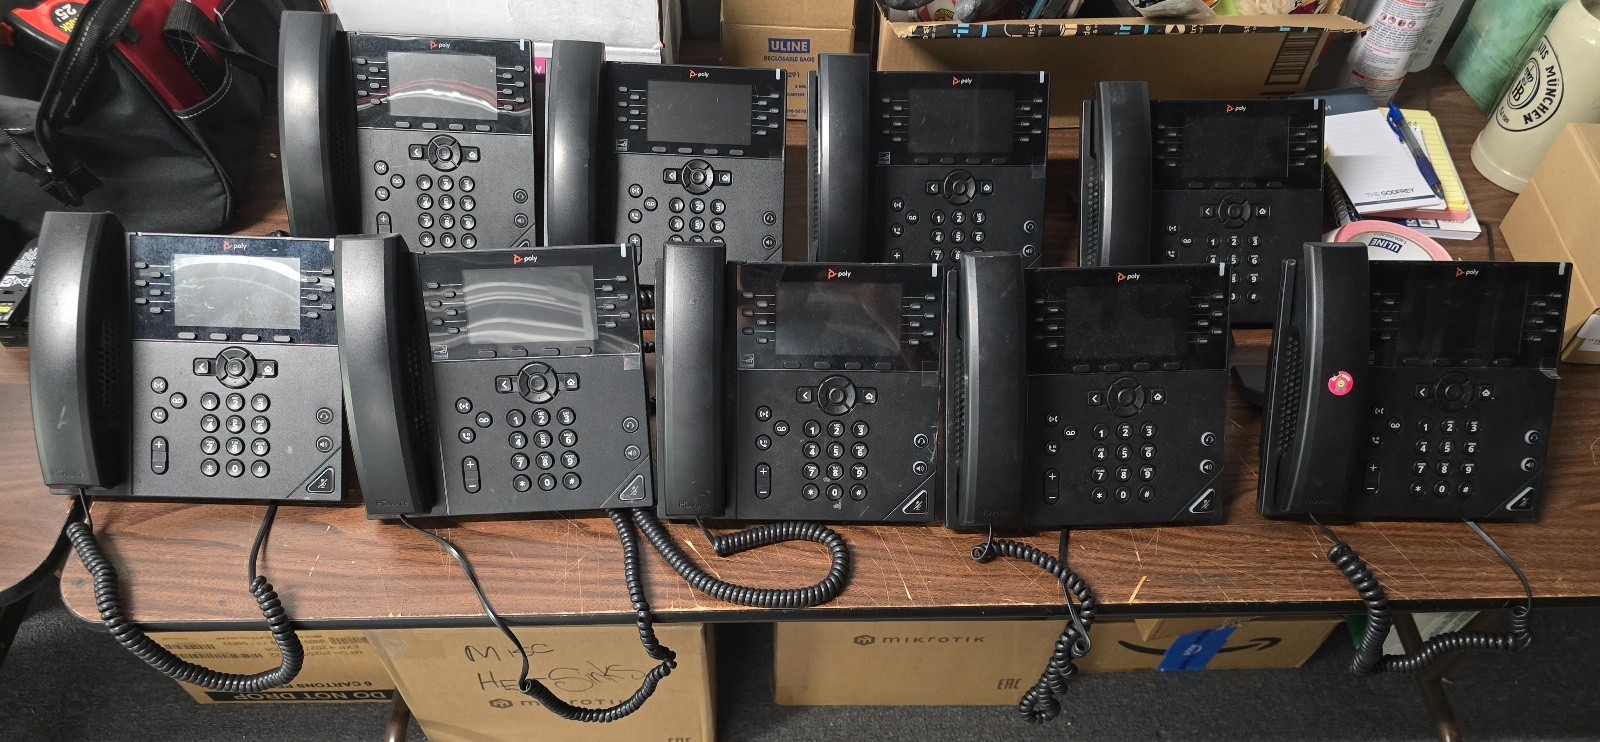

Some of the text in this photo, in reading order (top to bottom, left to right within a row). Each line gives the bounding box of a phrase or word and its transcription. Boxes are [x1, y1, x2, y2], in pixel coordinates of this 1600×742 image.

[770, 40, 808, 52] ULINE
[1380, 187, 1415, 196] GODFREY
[233, 242, 247, 250] poly
[1370, 237, 1400, 252] ULINE
[523, 254, 538, 263] poly
[838, 270, 852, 278] poly
[296, 681, 361, 689] CARTONS
[233, 690, 386, 701] DO NOT DROP
